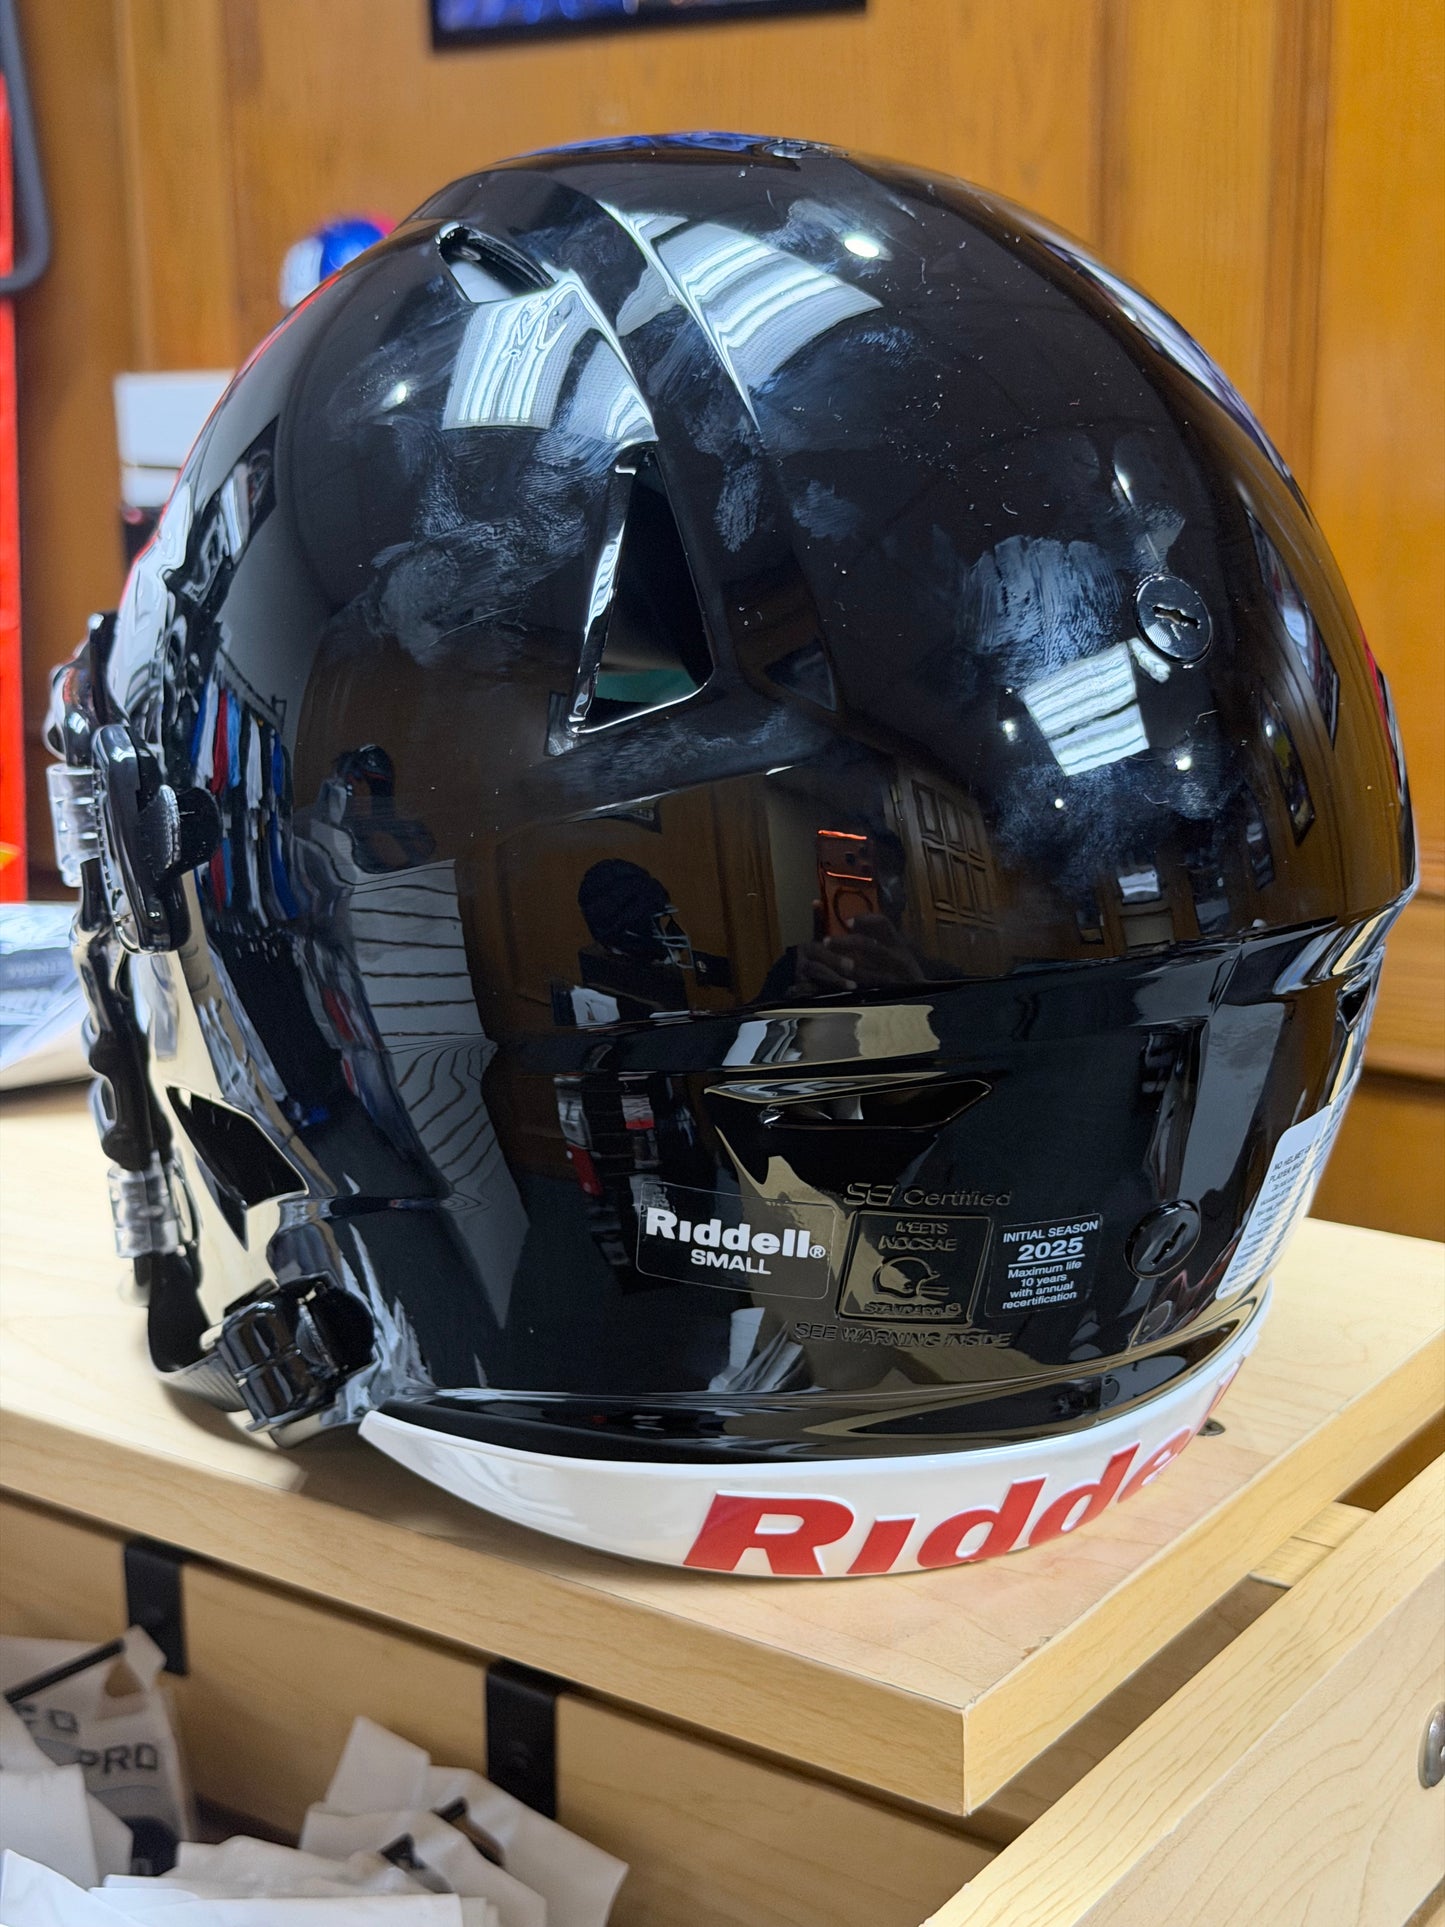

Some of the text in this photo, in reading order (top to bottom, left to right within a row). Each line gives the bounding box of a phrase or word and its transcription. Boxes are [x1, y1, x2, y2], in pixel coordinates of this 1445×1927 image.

[903, 1188, 1013, 1207] Certified
[895, 1221, 950, 1235] MEETS
[1002, 1220, 1099, 1243] INITIAL SEASON
[877, 1235, 959, 1251] NOCSAE
[1017, 1236, 1084, 1261] 2025
[690, 1249, 772, 1275] SMALL
[1007, 1259, 1082, 1279] Maximum life
[1009, 1281, 1074, 1299] with annual
[1020, 1273, 1068, 1287] 10 years
[1002, 1290, 1078, 1310] recertification
[794, 1322, 1013, 1348] SEE WARNING INSIDE
